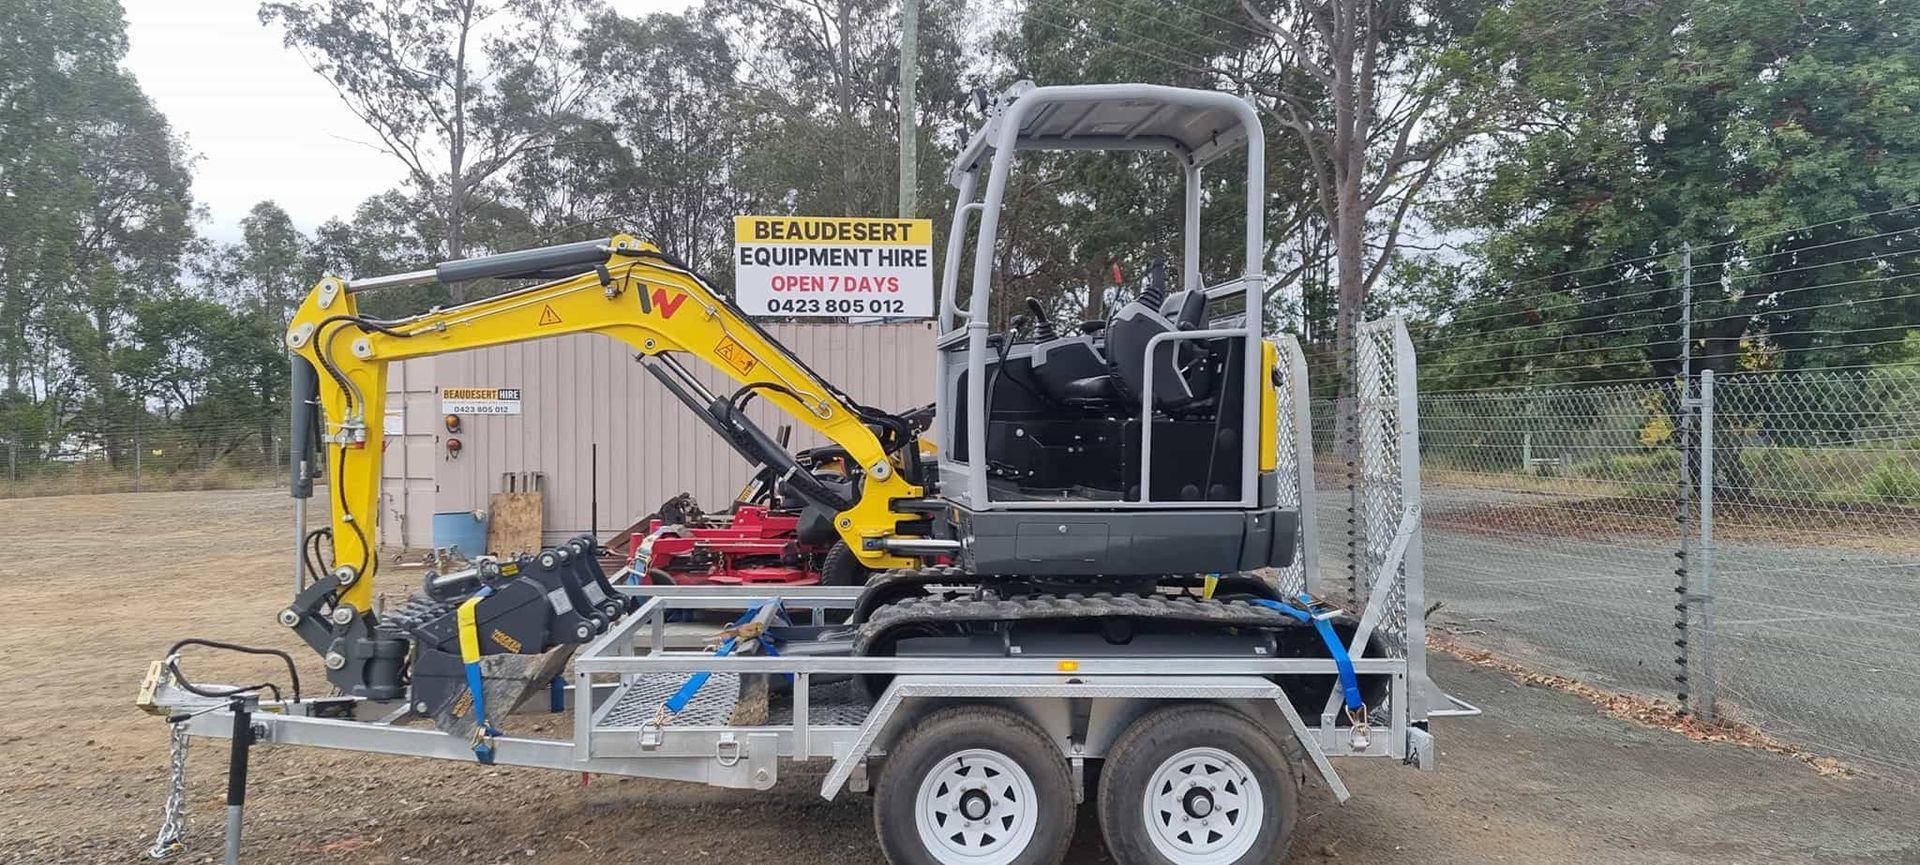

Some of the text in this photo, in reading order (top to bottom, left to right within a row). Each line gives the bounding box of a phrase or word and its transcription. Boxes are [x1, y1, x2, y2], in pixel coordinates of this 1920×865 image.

[755, 221, 912, 241] BEAUDESERT
[740, 247, 927, 267] EQUIPMENT HIRE
[771, 275, 899, 292] OPEN 7 DAYS
[767, 299, 904, 313] 0423 805 012
[443, 389, 520, 400] BEAUDESERT HIRE
